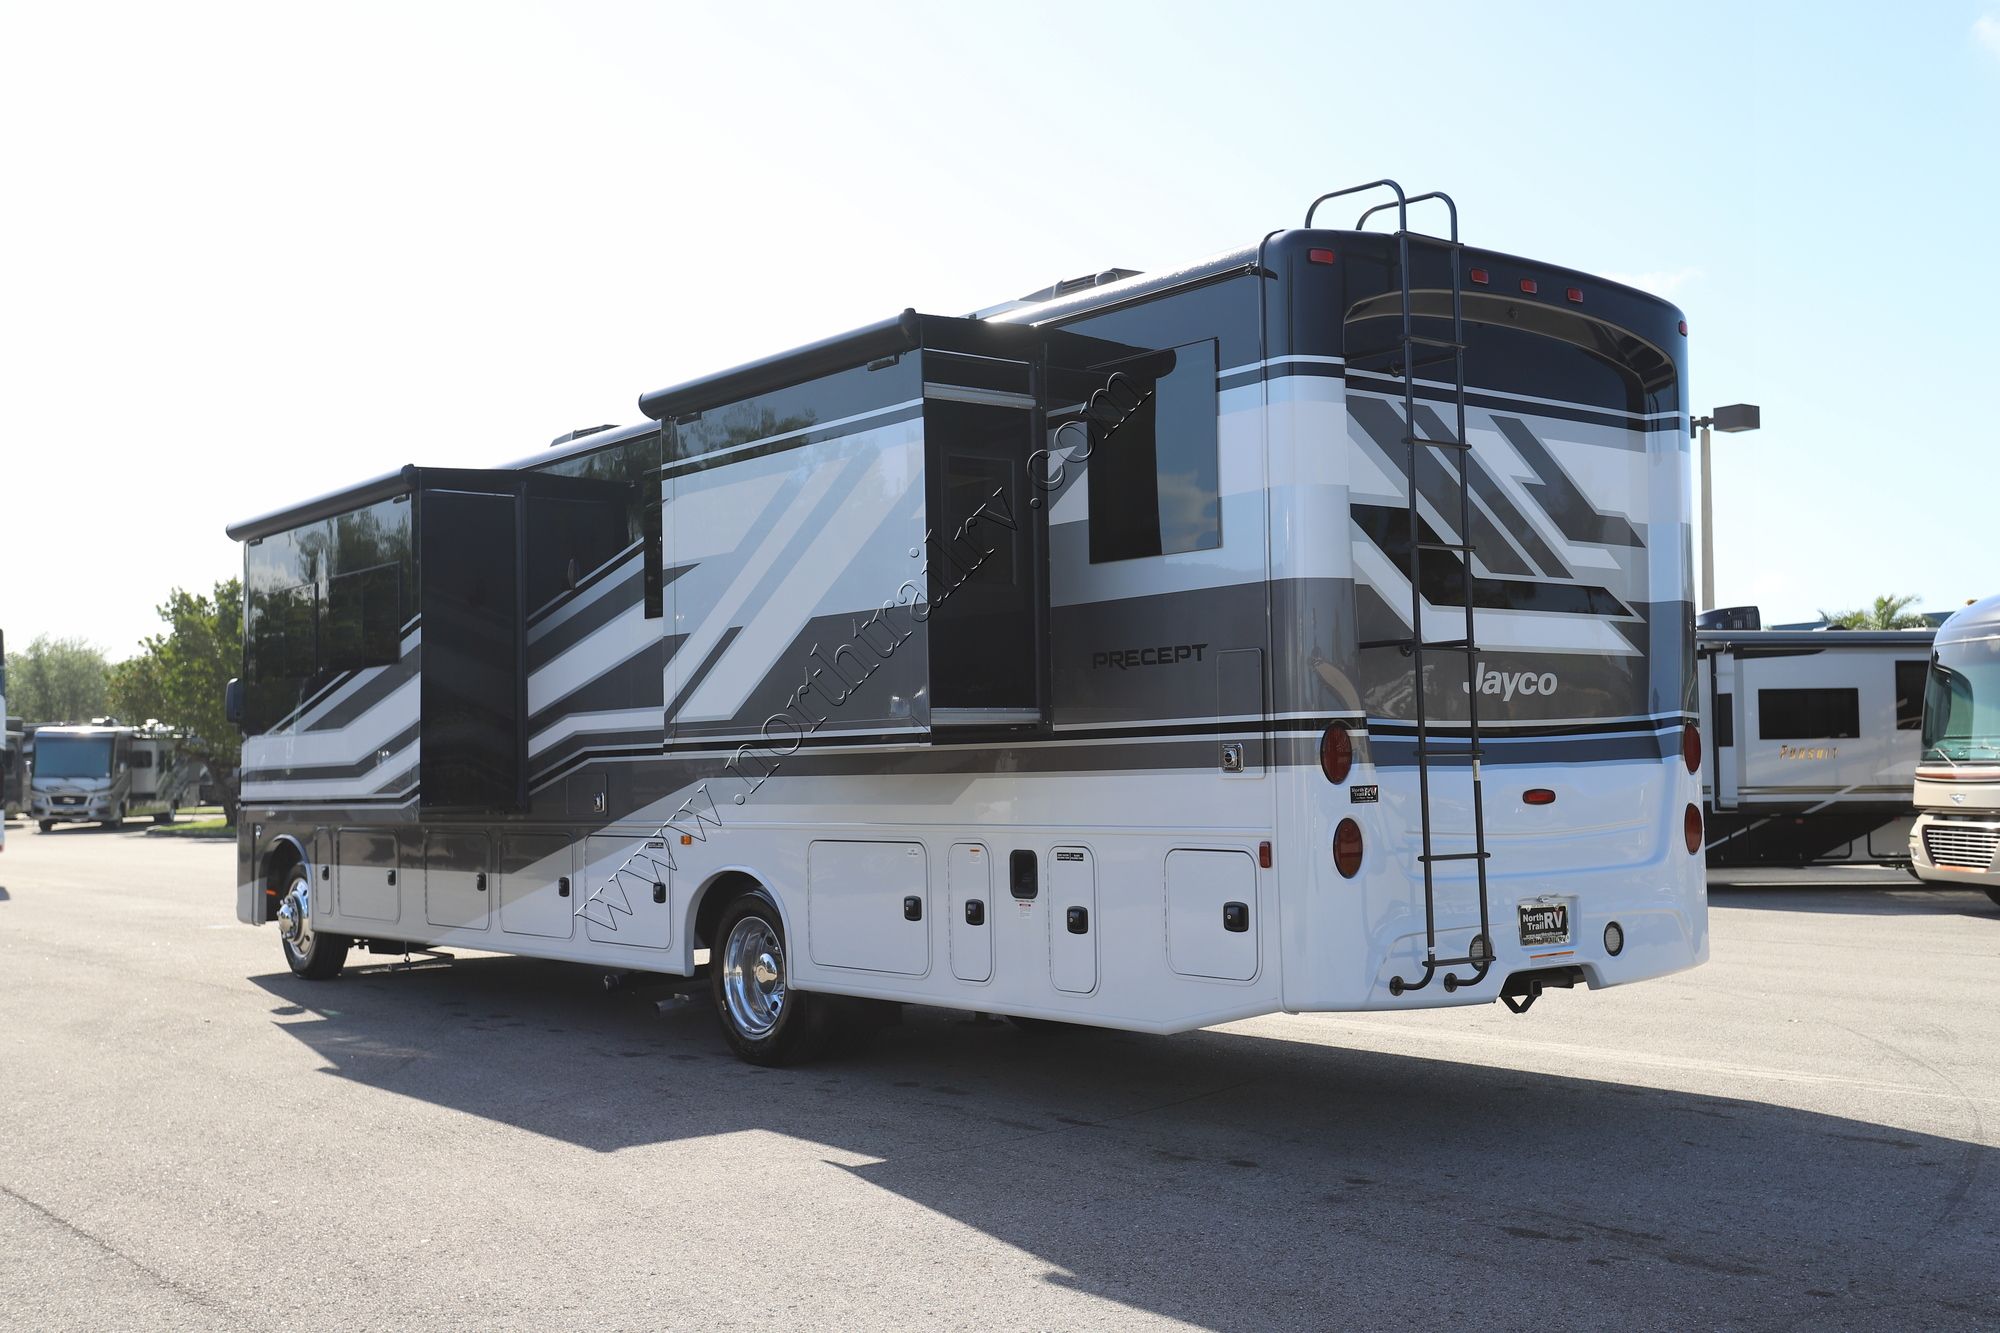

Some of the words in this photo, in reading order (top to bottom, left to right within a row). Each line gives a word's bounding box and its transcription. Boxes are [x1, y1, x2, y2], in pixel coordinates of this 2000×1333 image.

[1092, 643, 1208, 671] PRECEPT
[1462, 662, 1558, 702] Jayco
[1523, 914, 1543, 922] North
[1544, 911, 1563, 929] RV
[1527, 922, 1544, 931] Trail
